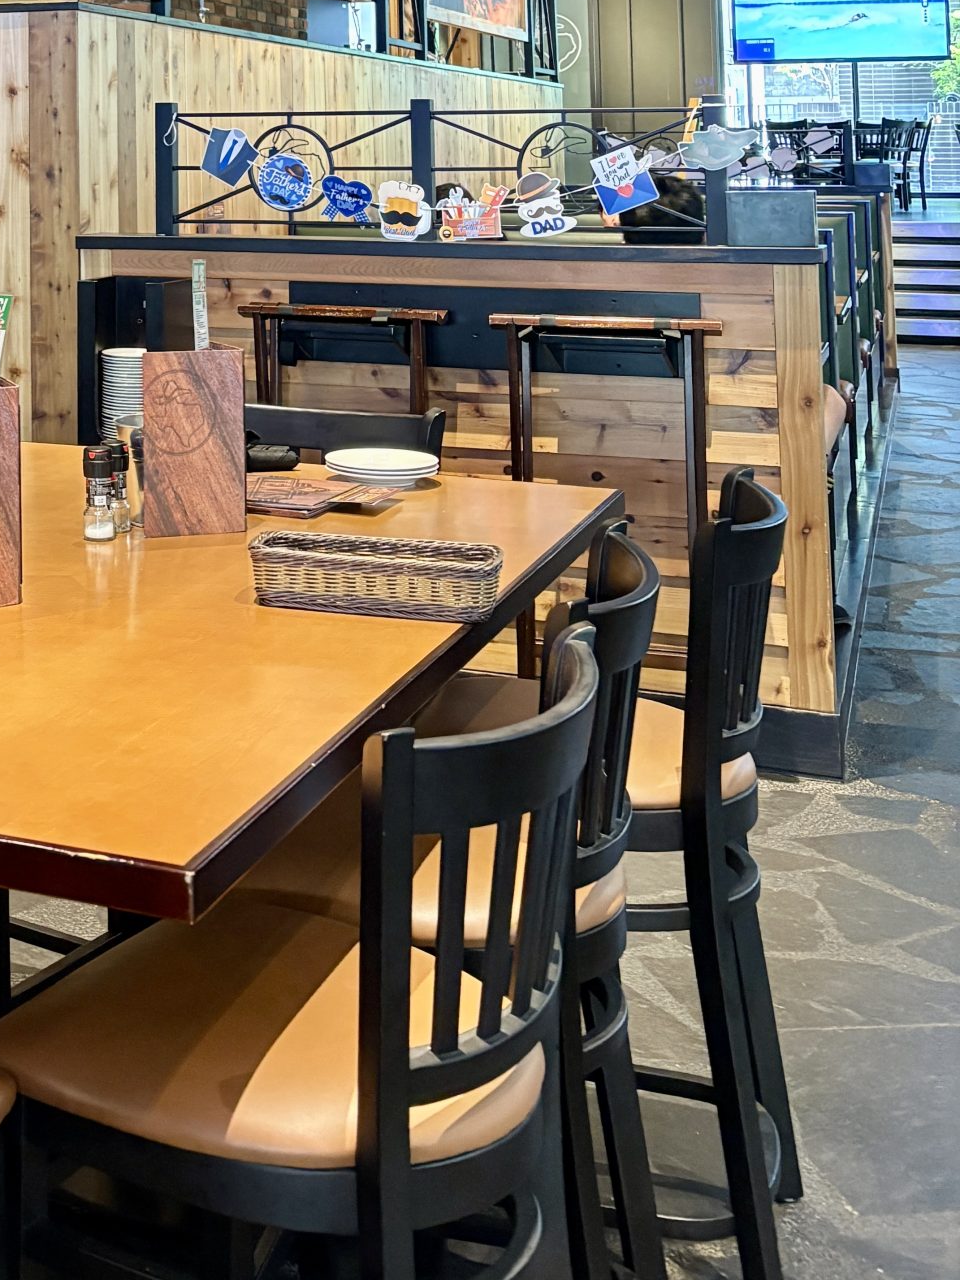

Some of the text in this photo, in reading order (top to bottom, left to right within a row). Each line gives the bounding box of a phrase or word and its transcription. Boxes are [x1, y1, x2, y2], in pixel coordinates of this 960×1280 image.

[604, 168, 618, 182] you
[612, 167, 630, 186] Dad
[272, 186, 291, 198] DAY
[334, 182, 359, 195] HAPPY
[337, 200, 357, 211] DAY
[531, 217, 566, 236] DAD
